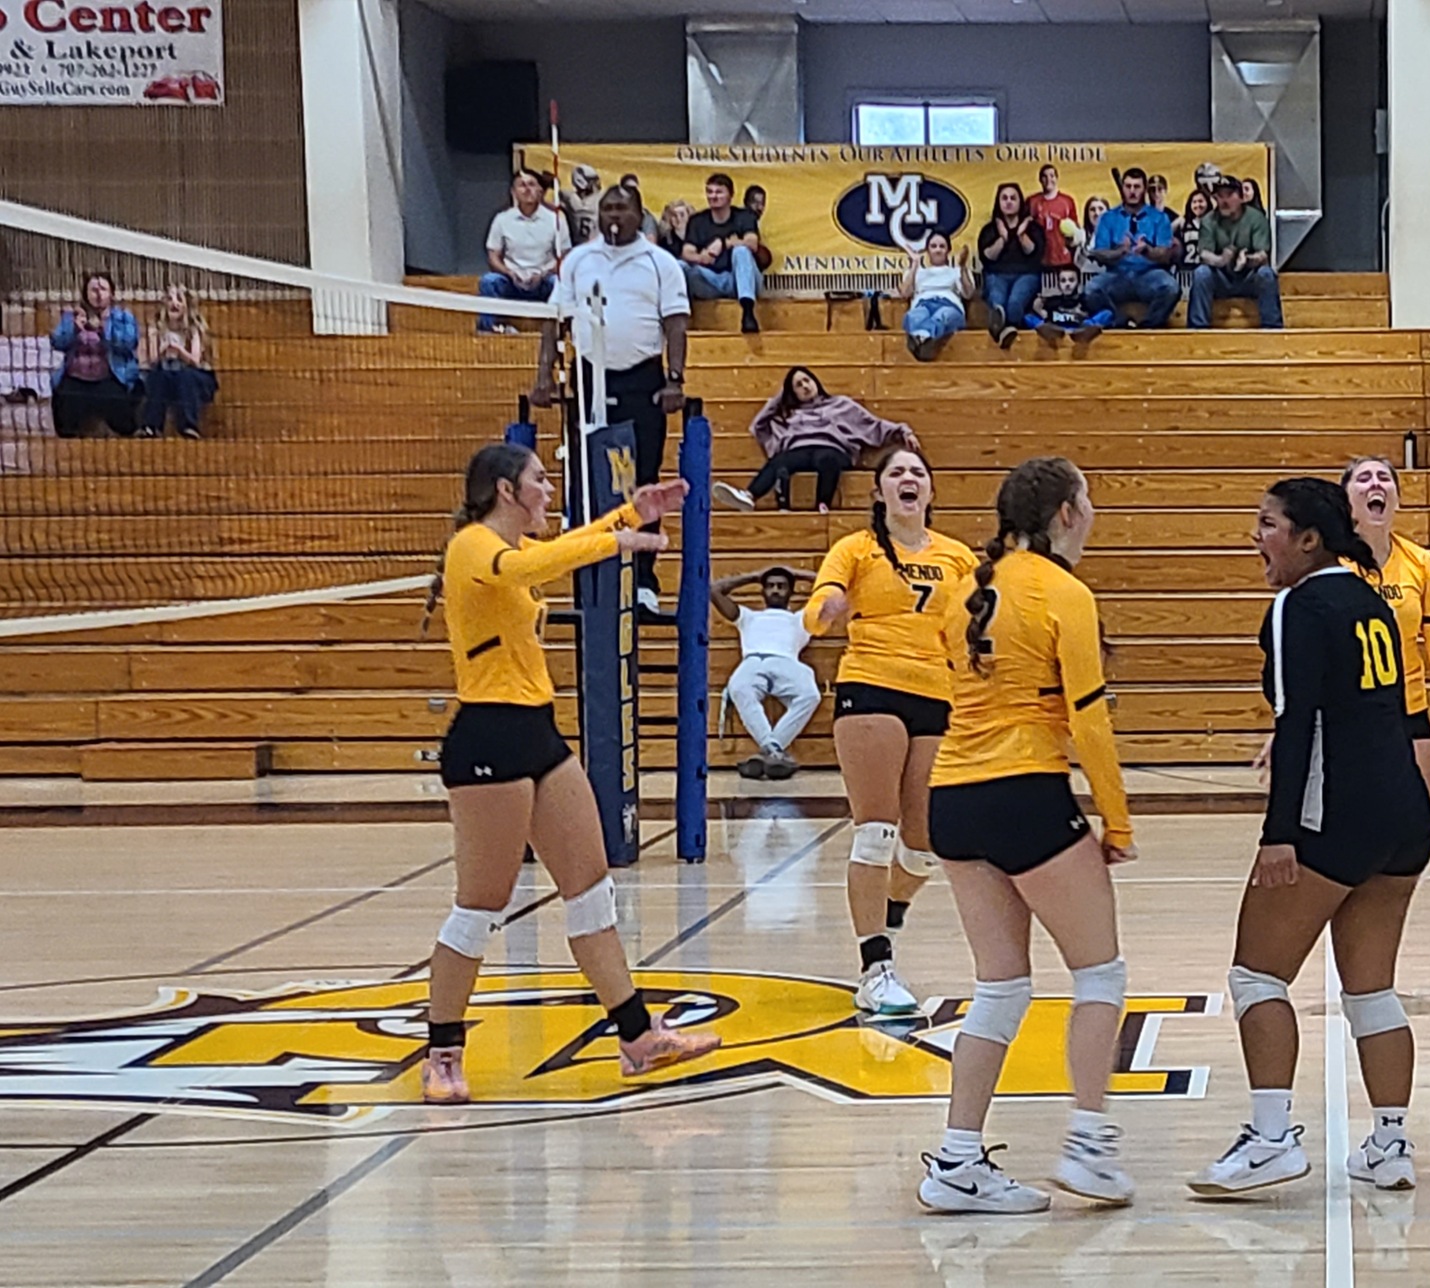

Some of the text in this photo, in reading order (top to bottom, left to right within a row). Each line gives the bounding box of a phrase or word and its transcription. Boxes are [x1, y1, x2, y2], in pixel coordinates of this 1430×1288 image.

[24, 0, 212, 34] Center
[10, 38, 177, 64] & Lakeport
[910, 583, 933, 613] 7
[1355, 618, 1398, 690] 10
